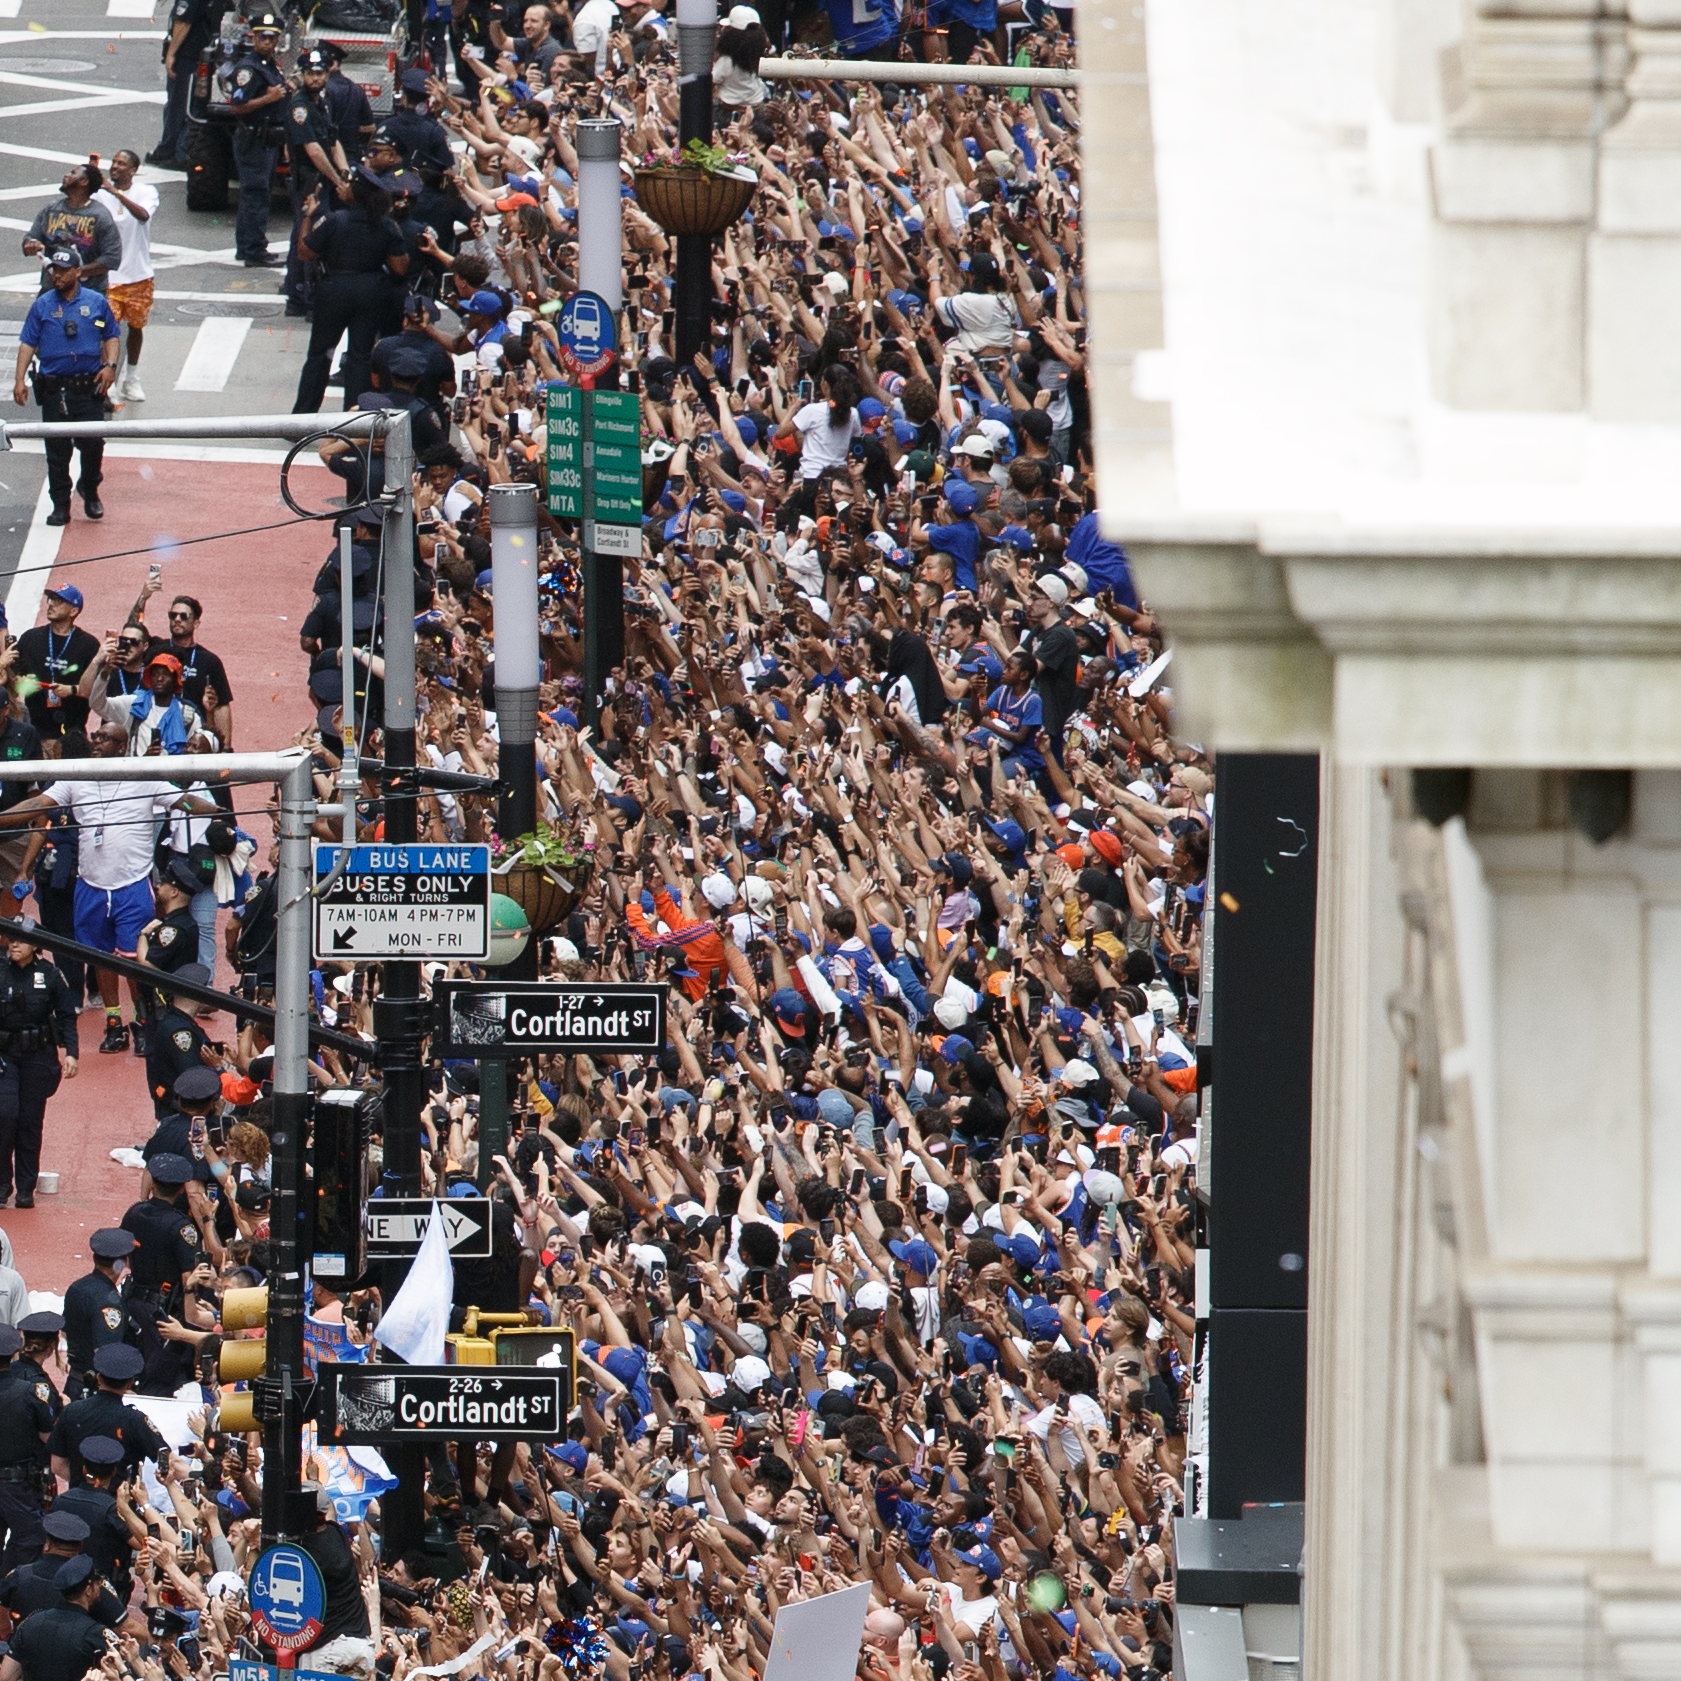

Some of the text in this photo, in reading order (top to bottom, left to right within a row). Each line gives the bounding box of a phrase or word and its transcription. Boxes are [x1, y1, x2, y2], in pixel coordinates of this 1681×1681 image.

[549, 391, 571, 410] SIM1
[549, 417, 578, 437] SIM3c
[549, 443, 573, 461] SIM4
[549, 494, 575, 512] MTA
[370, 852, 472, 869] BUS LANE
[416, 876, 474, 893] ONLY
[355, 893, 449, 903] & RIGHT TURNS
[387, 933, 463, 946] MON FRI
[558, 996, 585, 1009] 1-27
[510, 1008, 652, 1036] Cortlandt ST
[449, 1378, 483, 1393] 2-26
[400, 1393, 551, 1424] Cortlandt ST
[256, 1619, 315, 1649] NO STANDING
